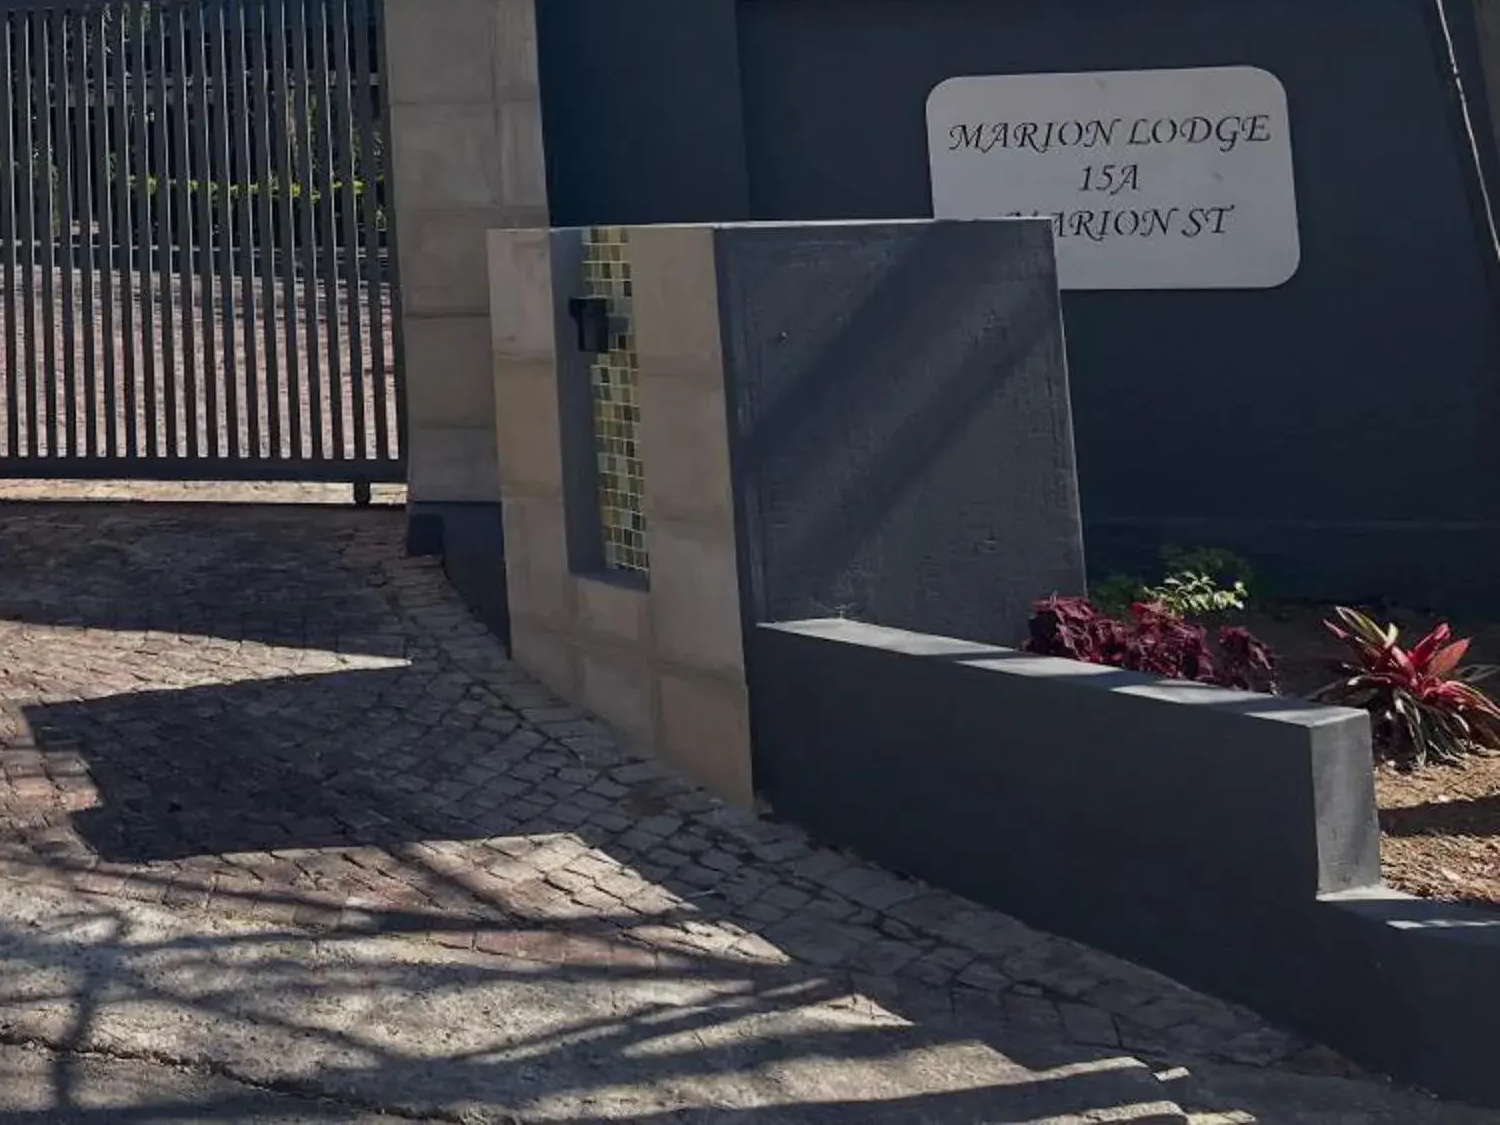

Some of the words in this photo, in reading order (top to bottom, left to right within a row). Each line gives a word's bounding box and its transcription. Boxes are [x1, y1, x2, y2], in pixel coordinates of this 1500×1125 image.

[948, 119, 1121, 154] MARION
[1127, 114, 1272, 152] LODGE
[1078, 164, 1141, 195] 15A
[1005, 208, 1179, 242] ARION
[1181, 203, 1236, 238] ST
